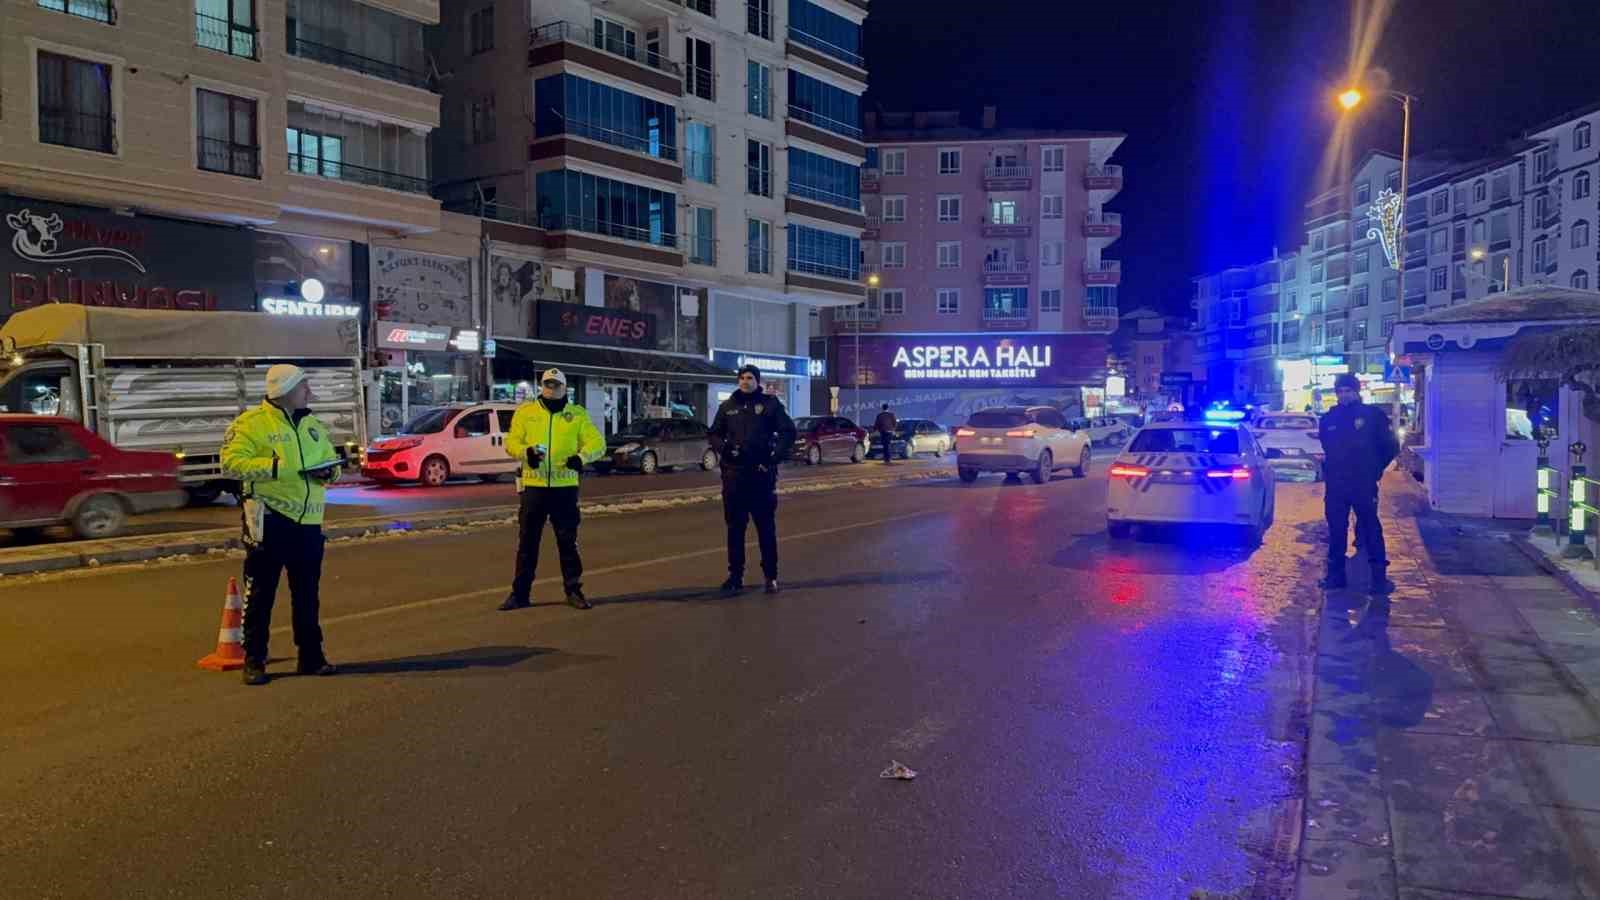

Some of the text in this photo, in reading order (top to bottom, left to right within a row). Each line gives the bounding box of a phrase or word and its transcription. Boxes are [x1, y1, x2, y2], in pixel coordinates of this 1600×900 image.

[585, 314, 648, 339] ENES
[892, 345, 1051, 367] ASPERA HALI
[904, 369, 925, 379] HEM
[968, 369, 989, 379] HEM
